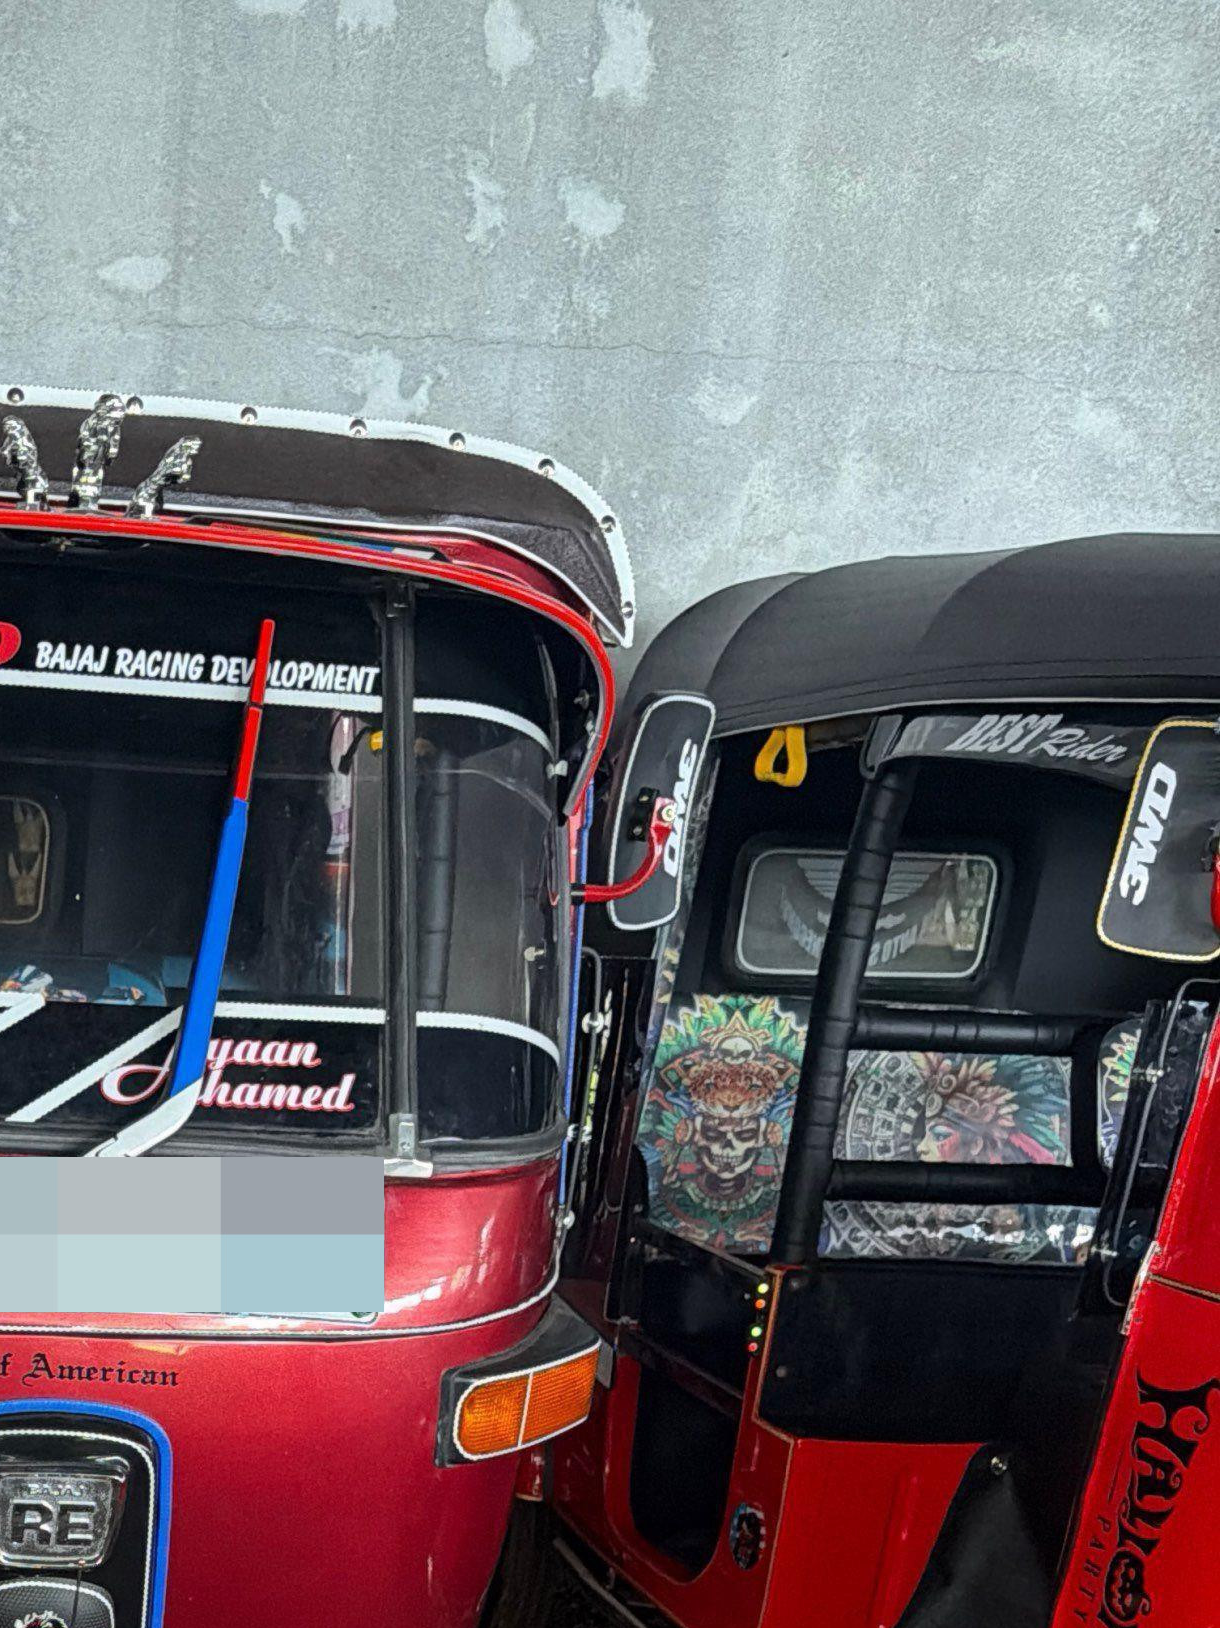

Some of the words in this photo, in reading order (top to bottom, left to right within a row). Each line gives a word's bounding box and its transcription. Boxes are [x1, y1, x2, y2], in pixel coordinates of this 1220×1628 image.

[36, 641, 110, 674] BAJAJ
[114, 648, 206, 682] RACING
[211, 655, 380, 694] DEVLOPMENT
[943, 713, 1064, 754] BEST
[1031, 728, 1128, 763] Rider
[663, 738, 698, 878] 3WD
[1119, 761, 1178, 906] 3WD
[197, 1069, 357, 1112] hamed
[21, 1353, 180, 1388] American
[10, 1499, 97, 1547] RE
[1077, 1511, 1114, 1624] PARTY
